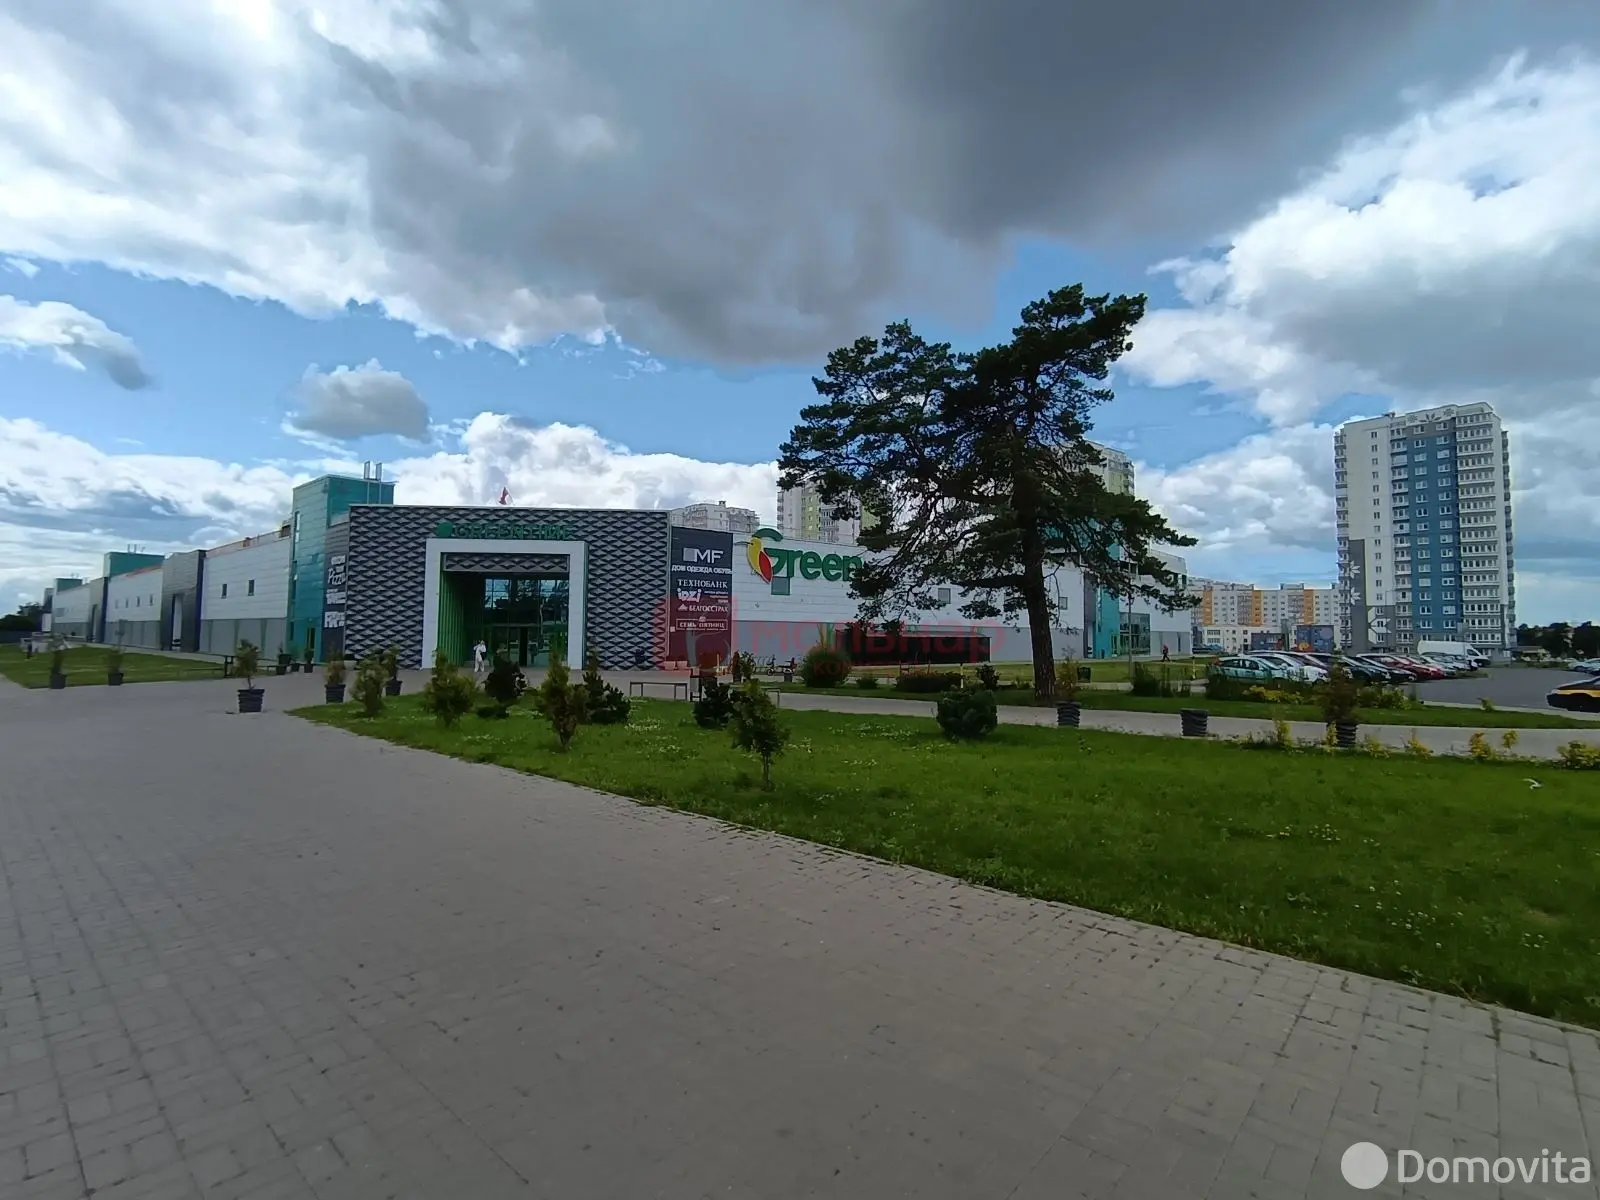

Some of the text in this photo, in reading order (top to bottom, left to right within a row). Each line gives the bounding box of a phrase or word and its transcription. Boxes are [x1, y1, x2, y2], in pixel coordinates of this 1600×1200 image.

[694, 548, 724, 564] MF
[747, 527, 866, 584] Green
[671, 564, 686, 572] ДОМ
[686, 565, 713, 574] ОДЕЖДА
[677, 578, 728, 589] ТЕХНОБАНК
[688, 605, 728, 613] БЕЛГОССТРАХ
